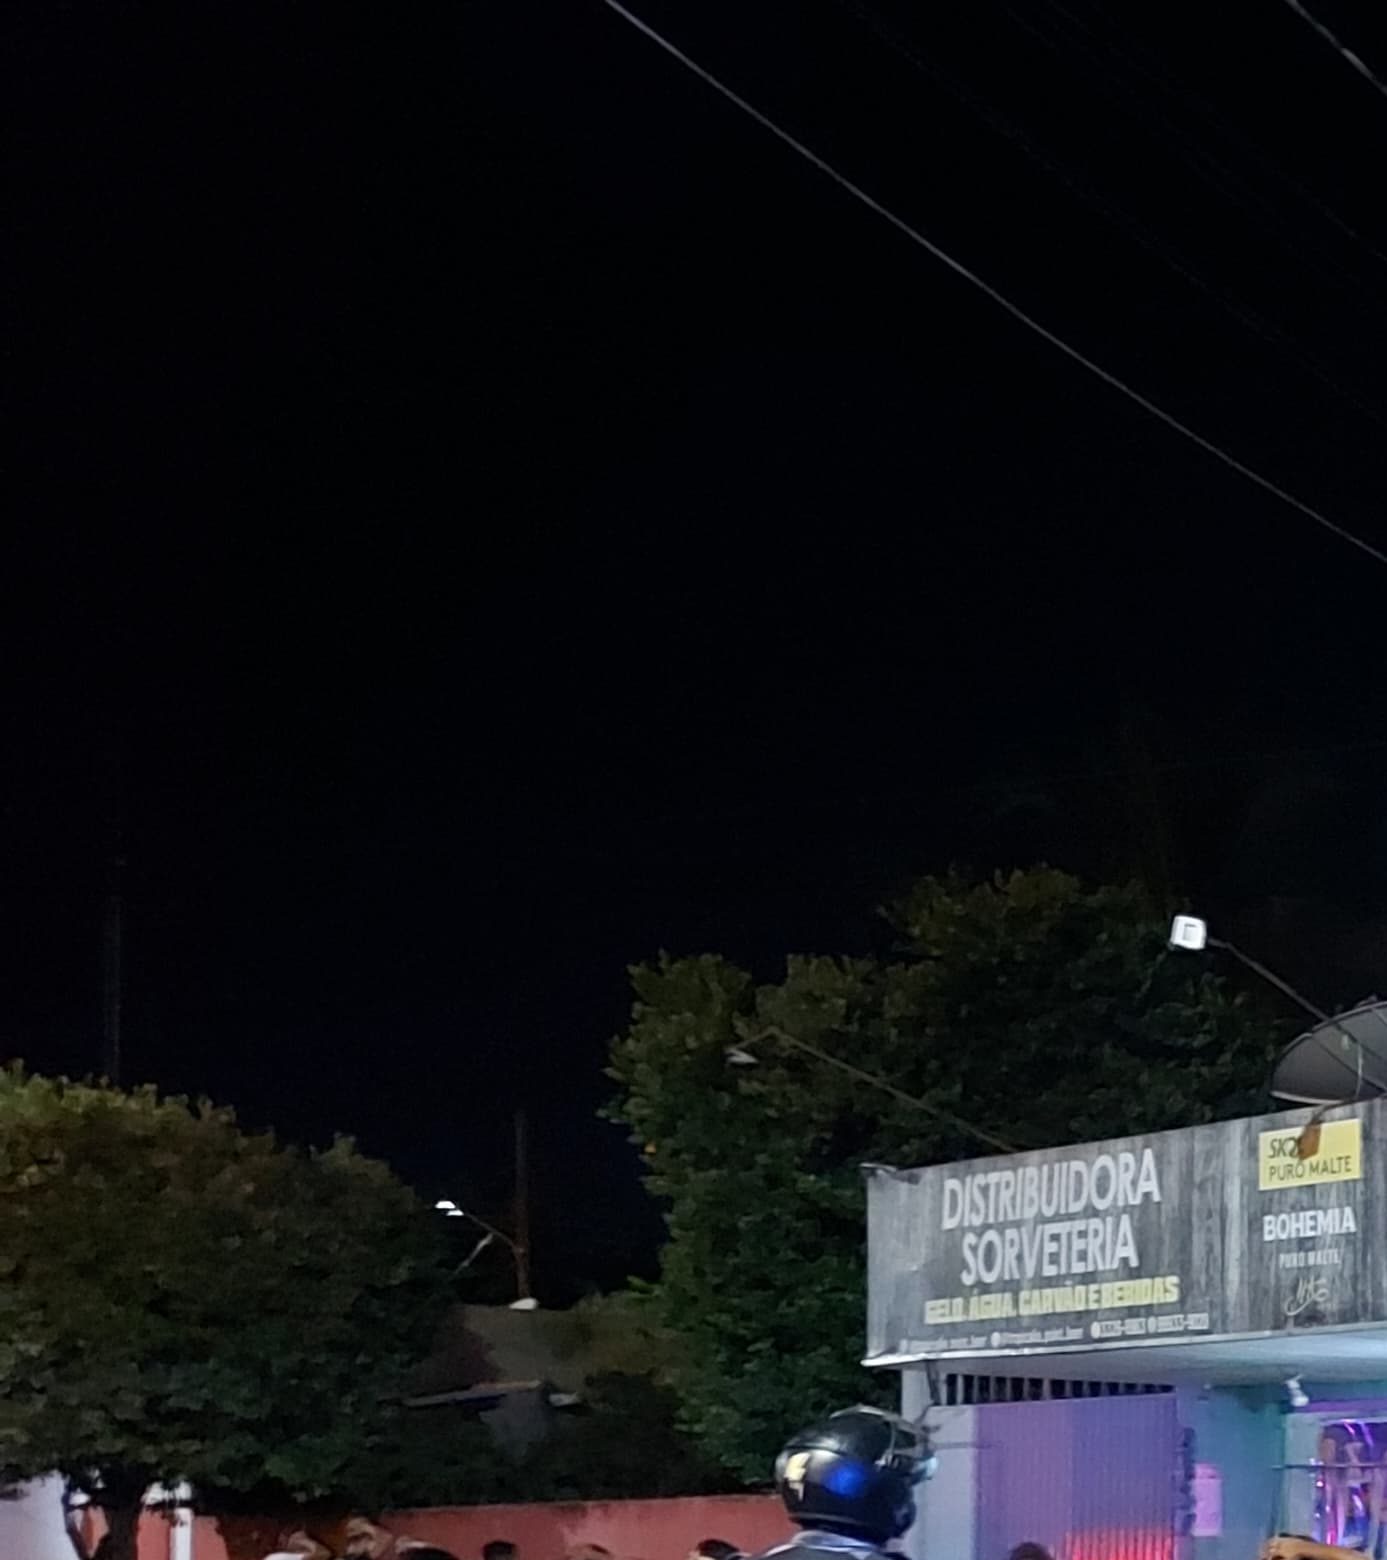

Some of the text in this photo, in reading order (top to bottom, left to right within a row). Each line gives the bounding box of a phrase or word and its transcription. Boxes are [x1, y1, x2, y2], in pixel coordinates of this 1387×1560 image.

[941, 1148, 1161, 1231] DISTRIBUIDORA
[1268, 1155, 1353, 1182] PURO MALTE
[1263, 1206, 1357, 1241] BOHEMIA
[960, 1216, 1140, 1287] SORVETERIA
